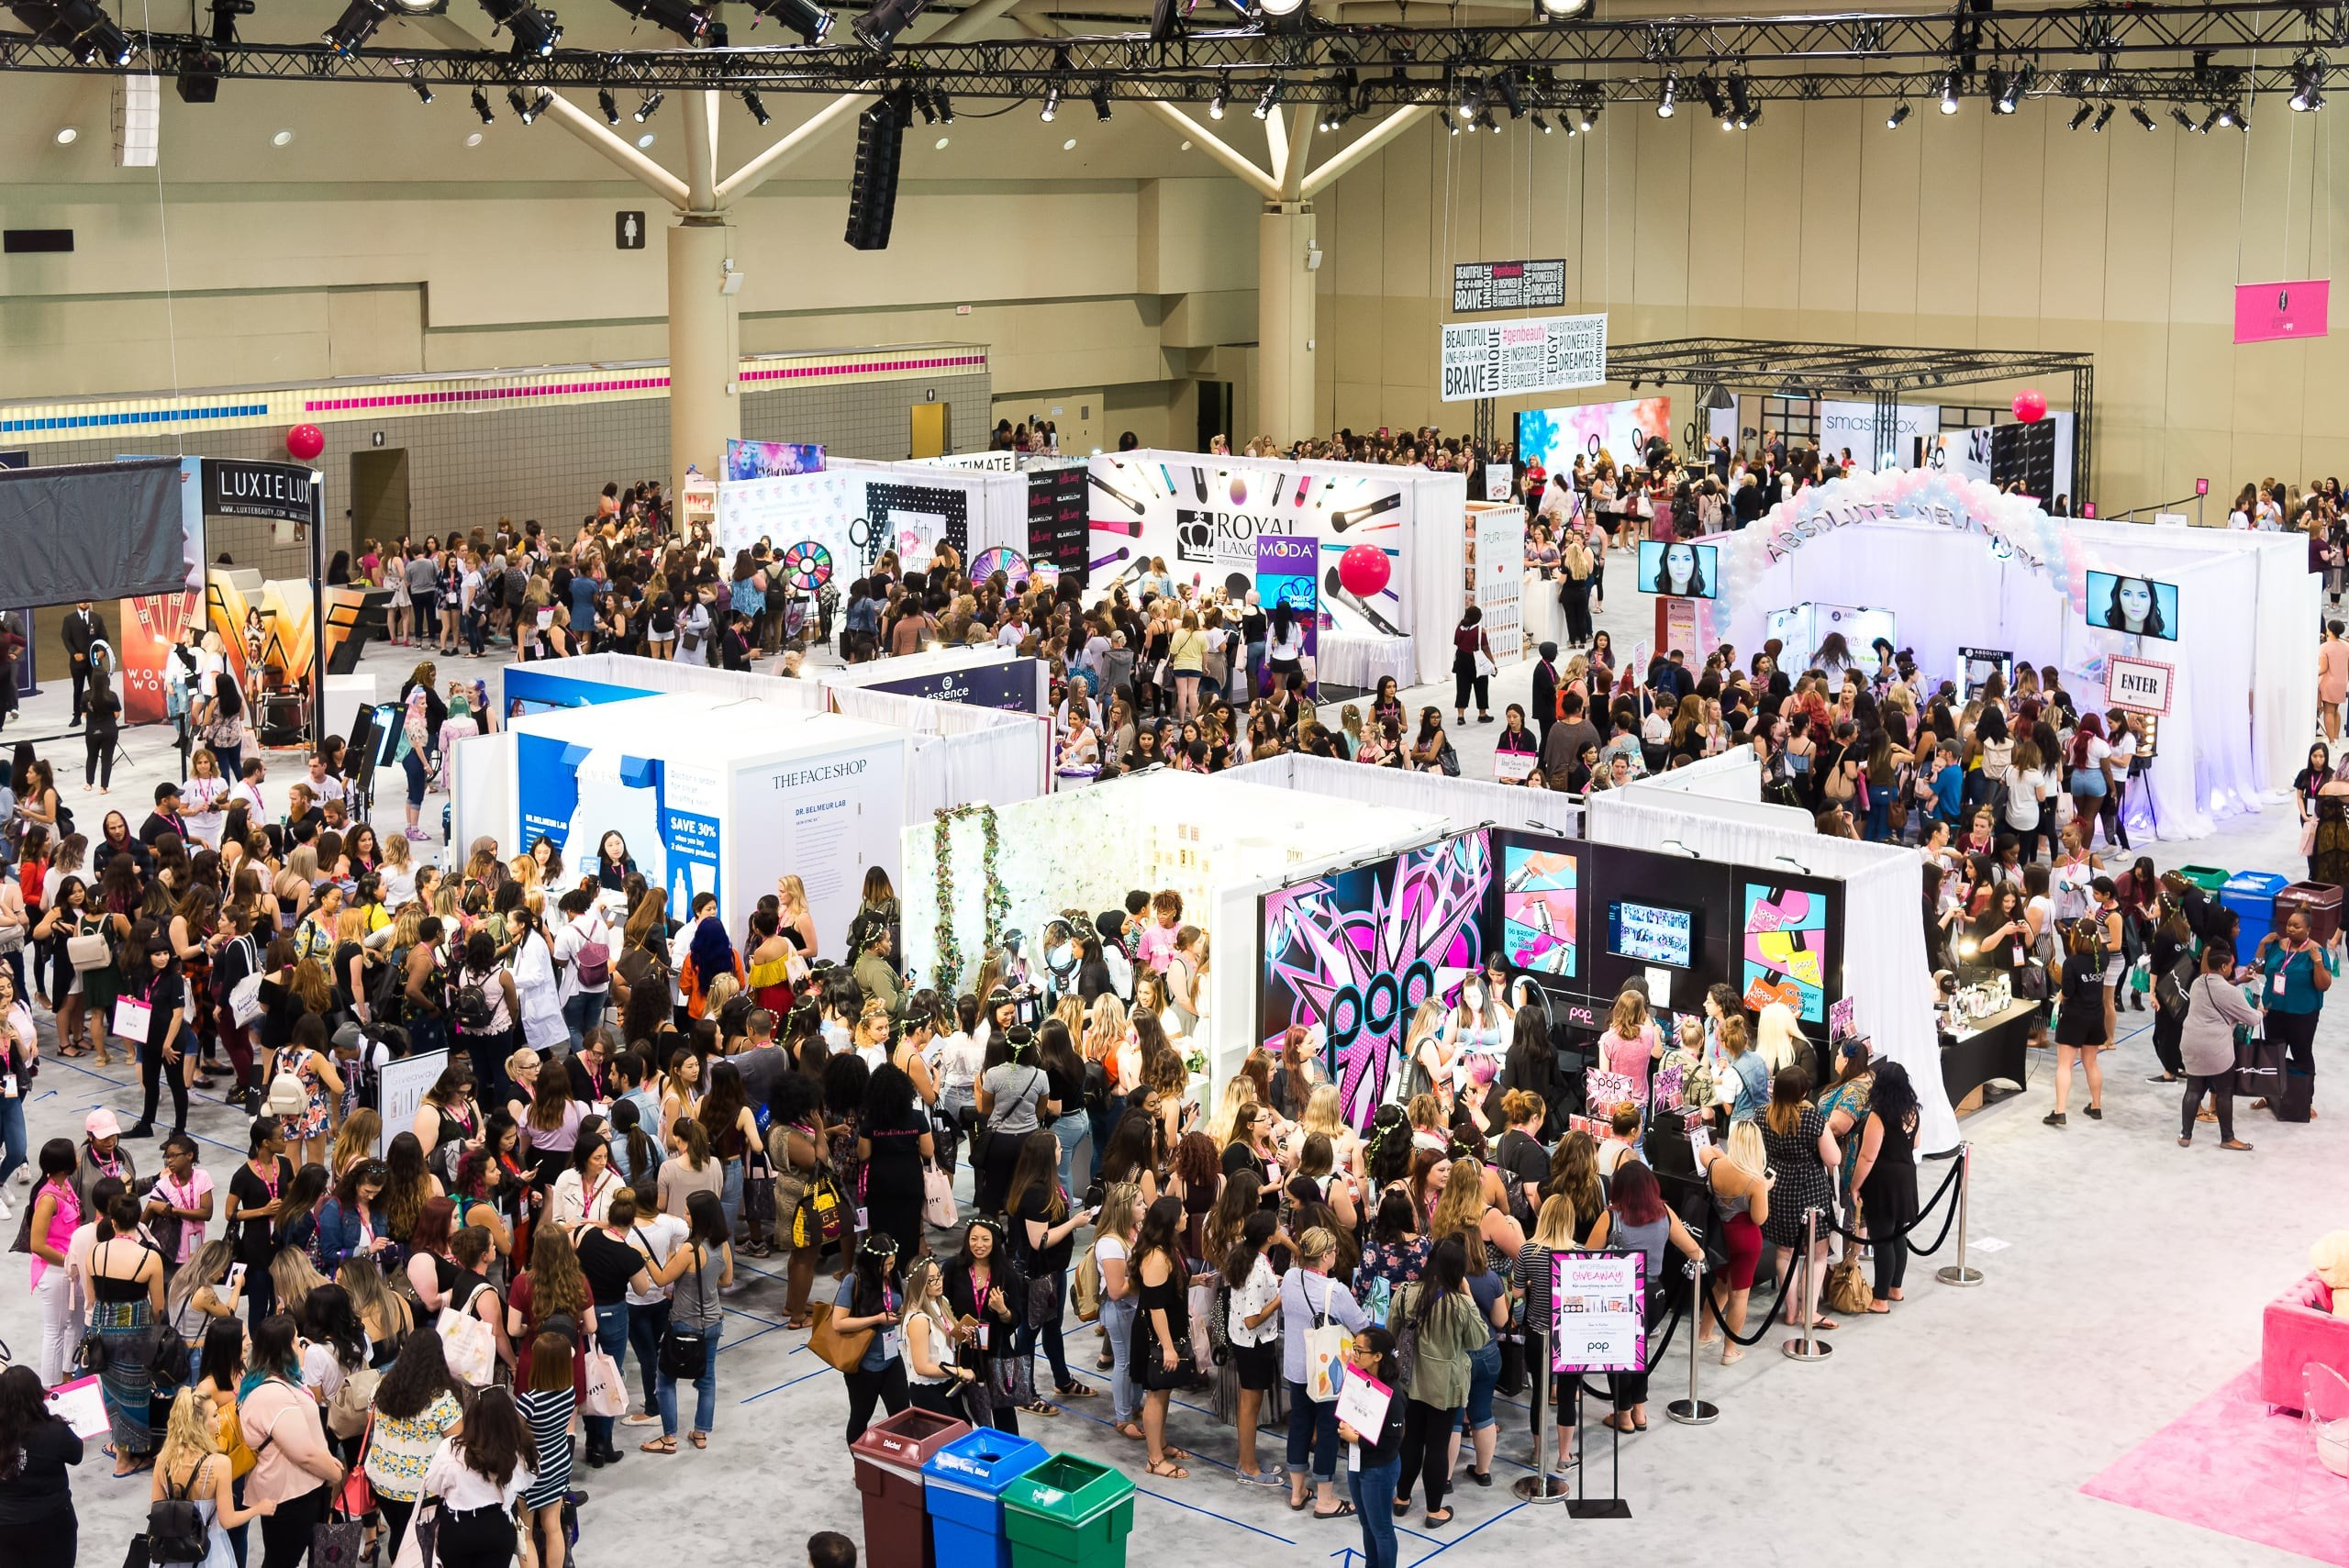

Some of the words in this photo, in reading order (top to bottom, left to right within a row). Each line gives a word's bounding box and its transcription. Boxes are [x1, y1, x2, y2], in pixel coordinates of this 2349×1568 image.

[1455, 265, 1483, 279] BEAUTIFUL
[1531, 271, 1554, 284] PIONEER
[1483, 264, 1493, 308] UNIQUE
[1523, 271, 1531, 298] EDGY
[1531, 282, 1557, 296] DREAMER
[1454, 289, 1483, 310] BRAVE
[1498, 295, 1517, 307] FEARLESS
[1559, 319, 1596, 333] EXTRAORDINARY
[1446, 328, 1486, 349] BEAUTIFUL
[1502, 325, 1545, 346] #genbeauty
[1559, 333, 1589, 350] PIONEER
[1445, 349, 1487, 364] ONE-OF-A-KIND
[1511, 345, 1538, 361] INSPIRED
[1547, 335, 1558, 373] EDGY
[1595, 318, 1603, 381] GLAMOROUS
[1487, 327, 1500, 392] UNIQUE
[1559, 350, 1594, 371] DREAMER
[1502, 348, 1510, 390] CREATIVE
[1547, 370, 1595, 385] OUT-OF-THIS-WORLD
[1445, 364, 1486, 396] BRAVE
[1510, 373, 1538, 389] FEARLESS
[221, 471, 284, 500] LUXIE
[220, 506, 286, 517] WWW.LUXIEBEAUTY.COM
[1766, 501, 1901, 563] ABSOLUTE
[1974, 650, 2004, 658] ABSOLUTE
[2121, 673, 2157, 695] ENTER
[926, 686, 969, 700] essence
[772, 772, 798, 790] THE
[800, 766, 831, 784] FACE
[832, 759, 867, 779] SHOP
[796, 807, 805, 816] DR.
[806, 802, 834, 814] BELMEUR
[834, 799, 846, 807] LAB
[670, 816, 696, 834] SAVE
[697, 822, 717, 838] 30%
[1516, 929, 1536, 939] BRIGHT
[1796, 990, 1819, 1001] BRIGHT
[1569, 1006, 1594, 1026] pop
[390, 1067, 439, 1085] Giveaway!
[1598, 1076, 1621, 1094] pop
[1572, 1270, 1624, 1284] GIVEAWAY!
[1587, 1341, 1609, 1353] pop
[883, 1439, 902, 1451] Déchet
[974, 1466, 990, 1478] Métal
